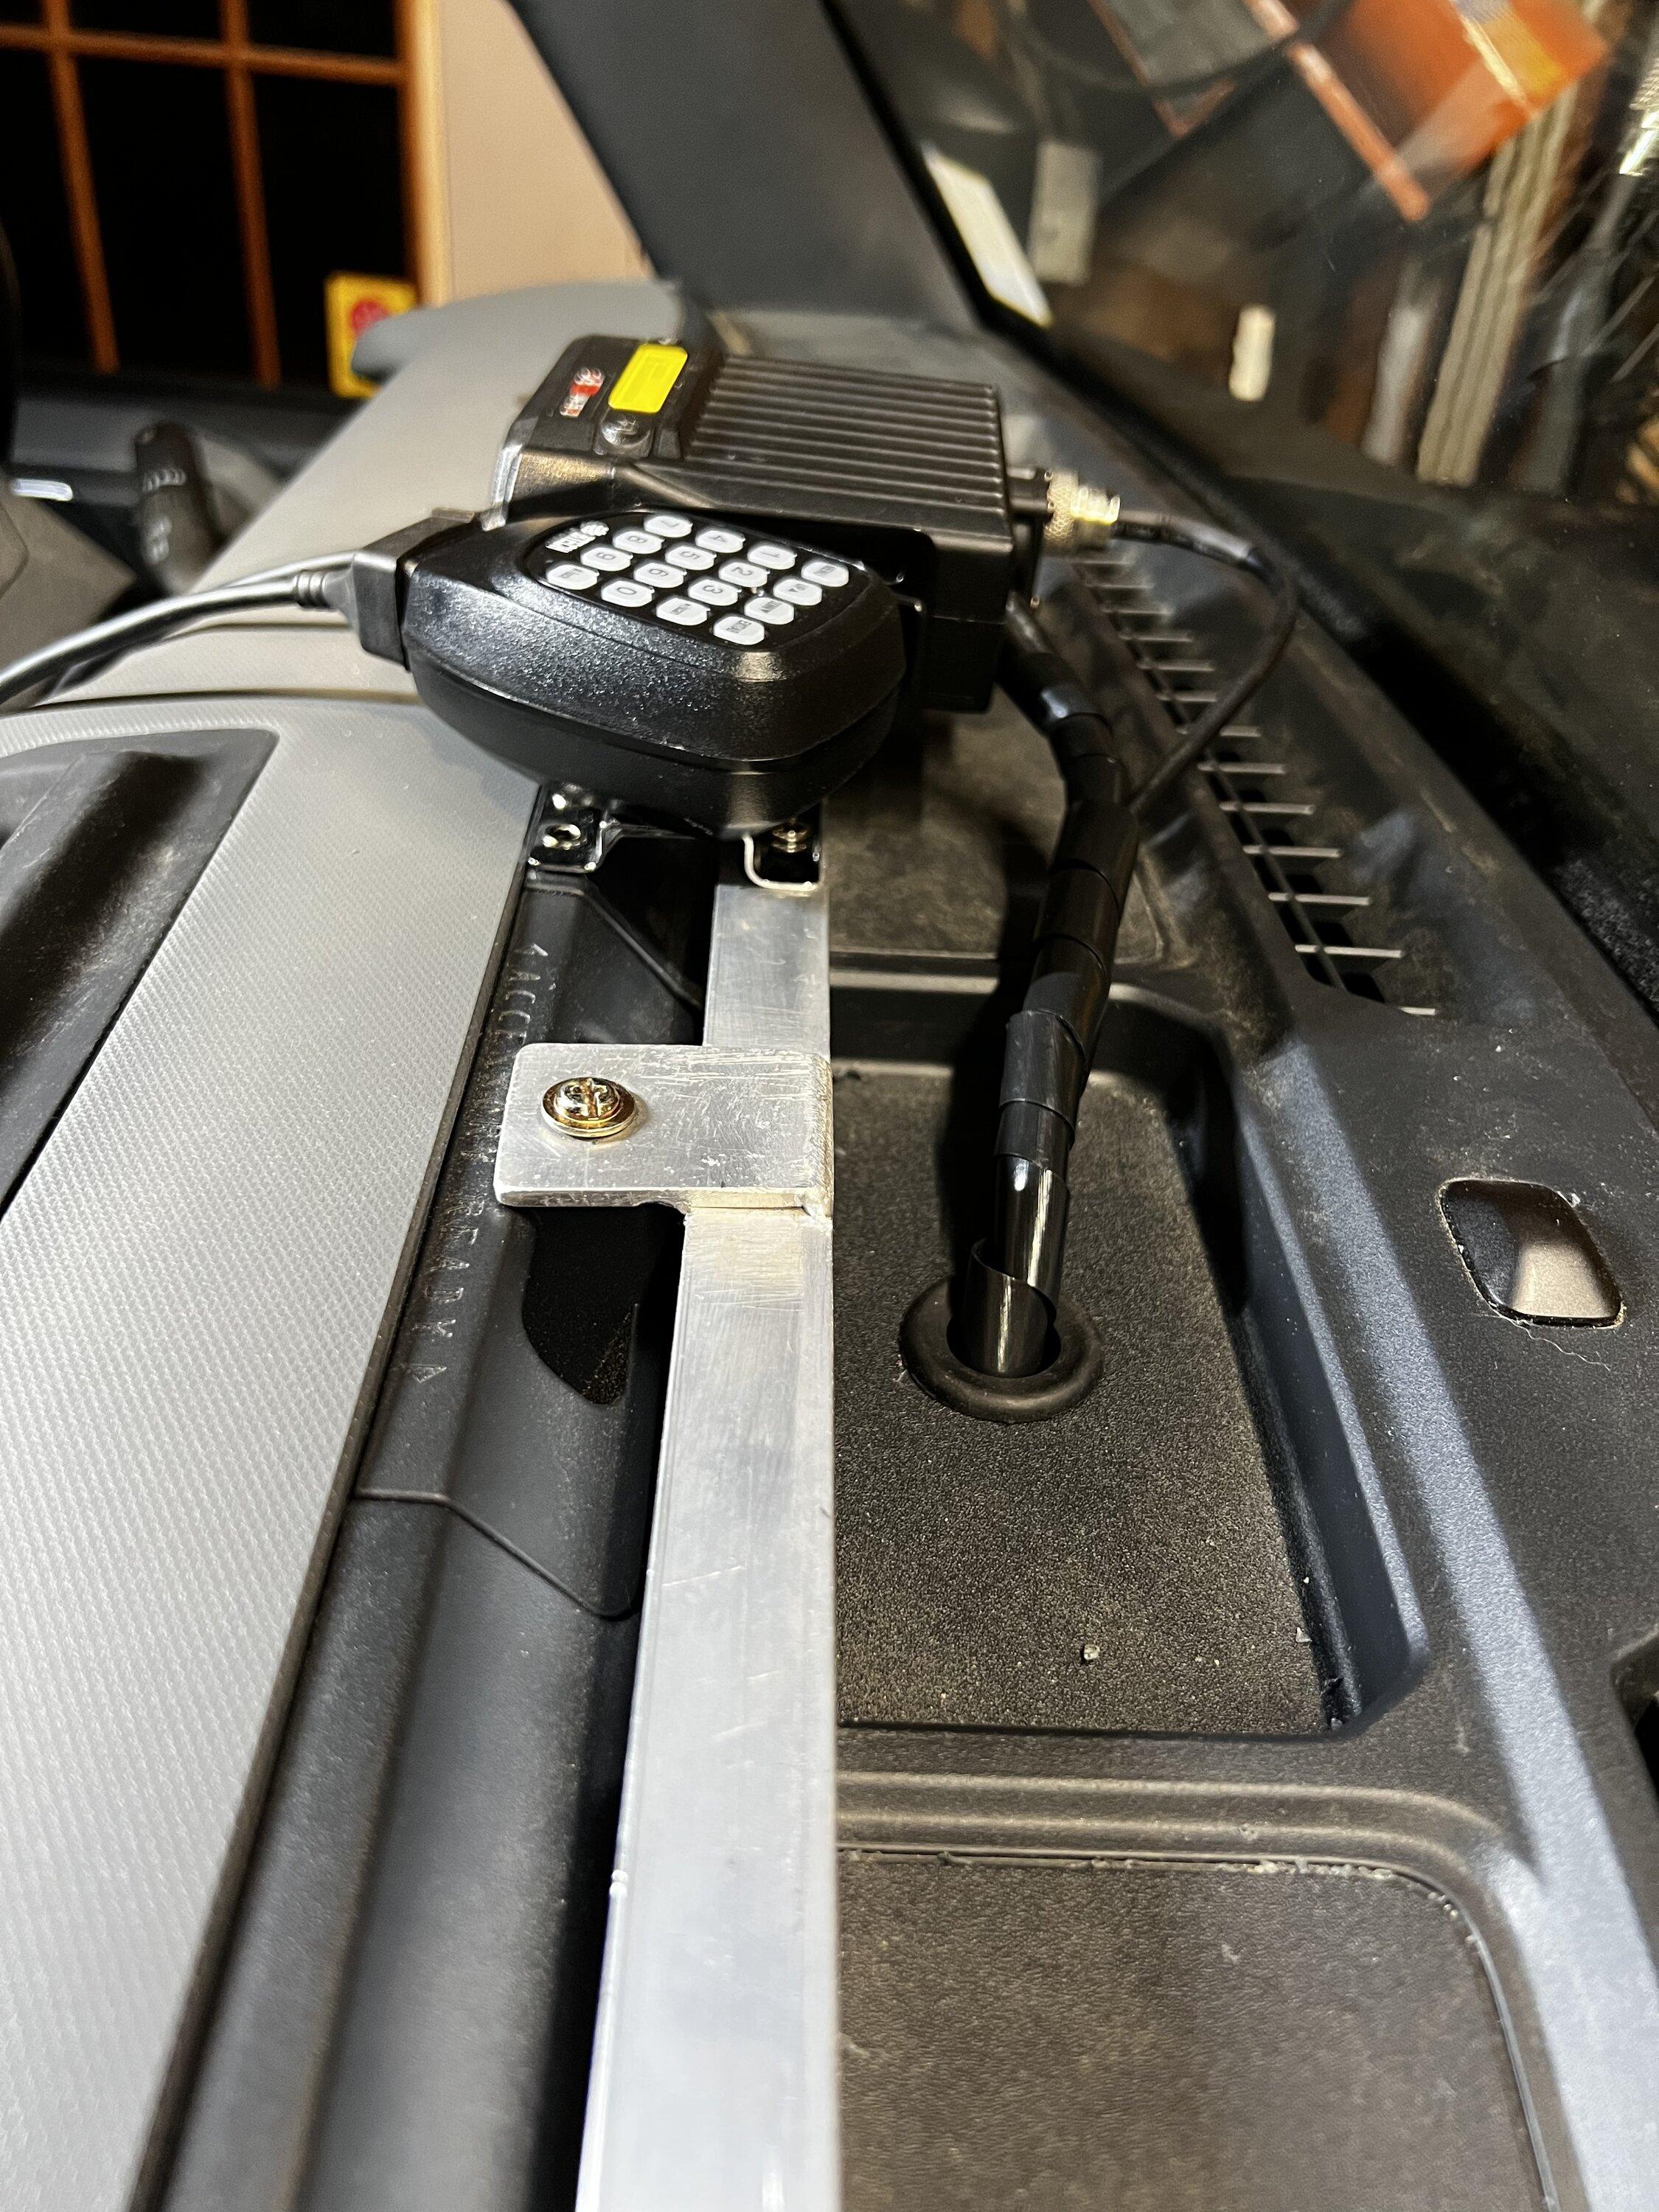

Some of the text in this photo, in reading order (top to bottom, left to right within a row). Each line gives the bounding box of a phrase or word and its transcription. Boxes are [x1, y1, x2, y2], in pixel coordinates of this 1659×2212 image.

[626, 535, 647, 543] 8
[595, 552, 616, 560] 9
[678, 550, 701, 560] 5
[648, 568, 669, 577] 6
[731, 566, 755, 577] 2
[616, 587, 637, 595] 0
[701, 584, 724, 594] 3
